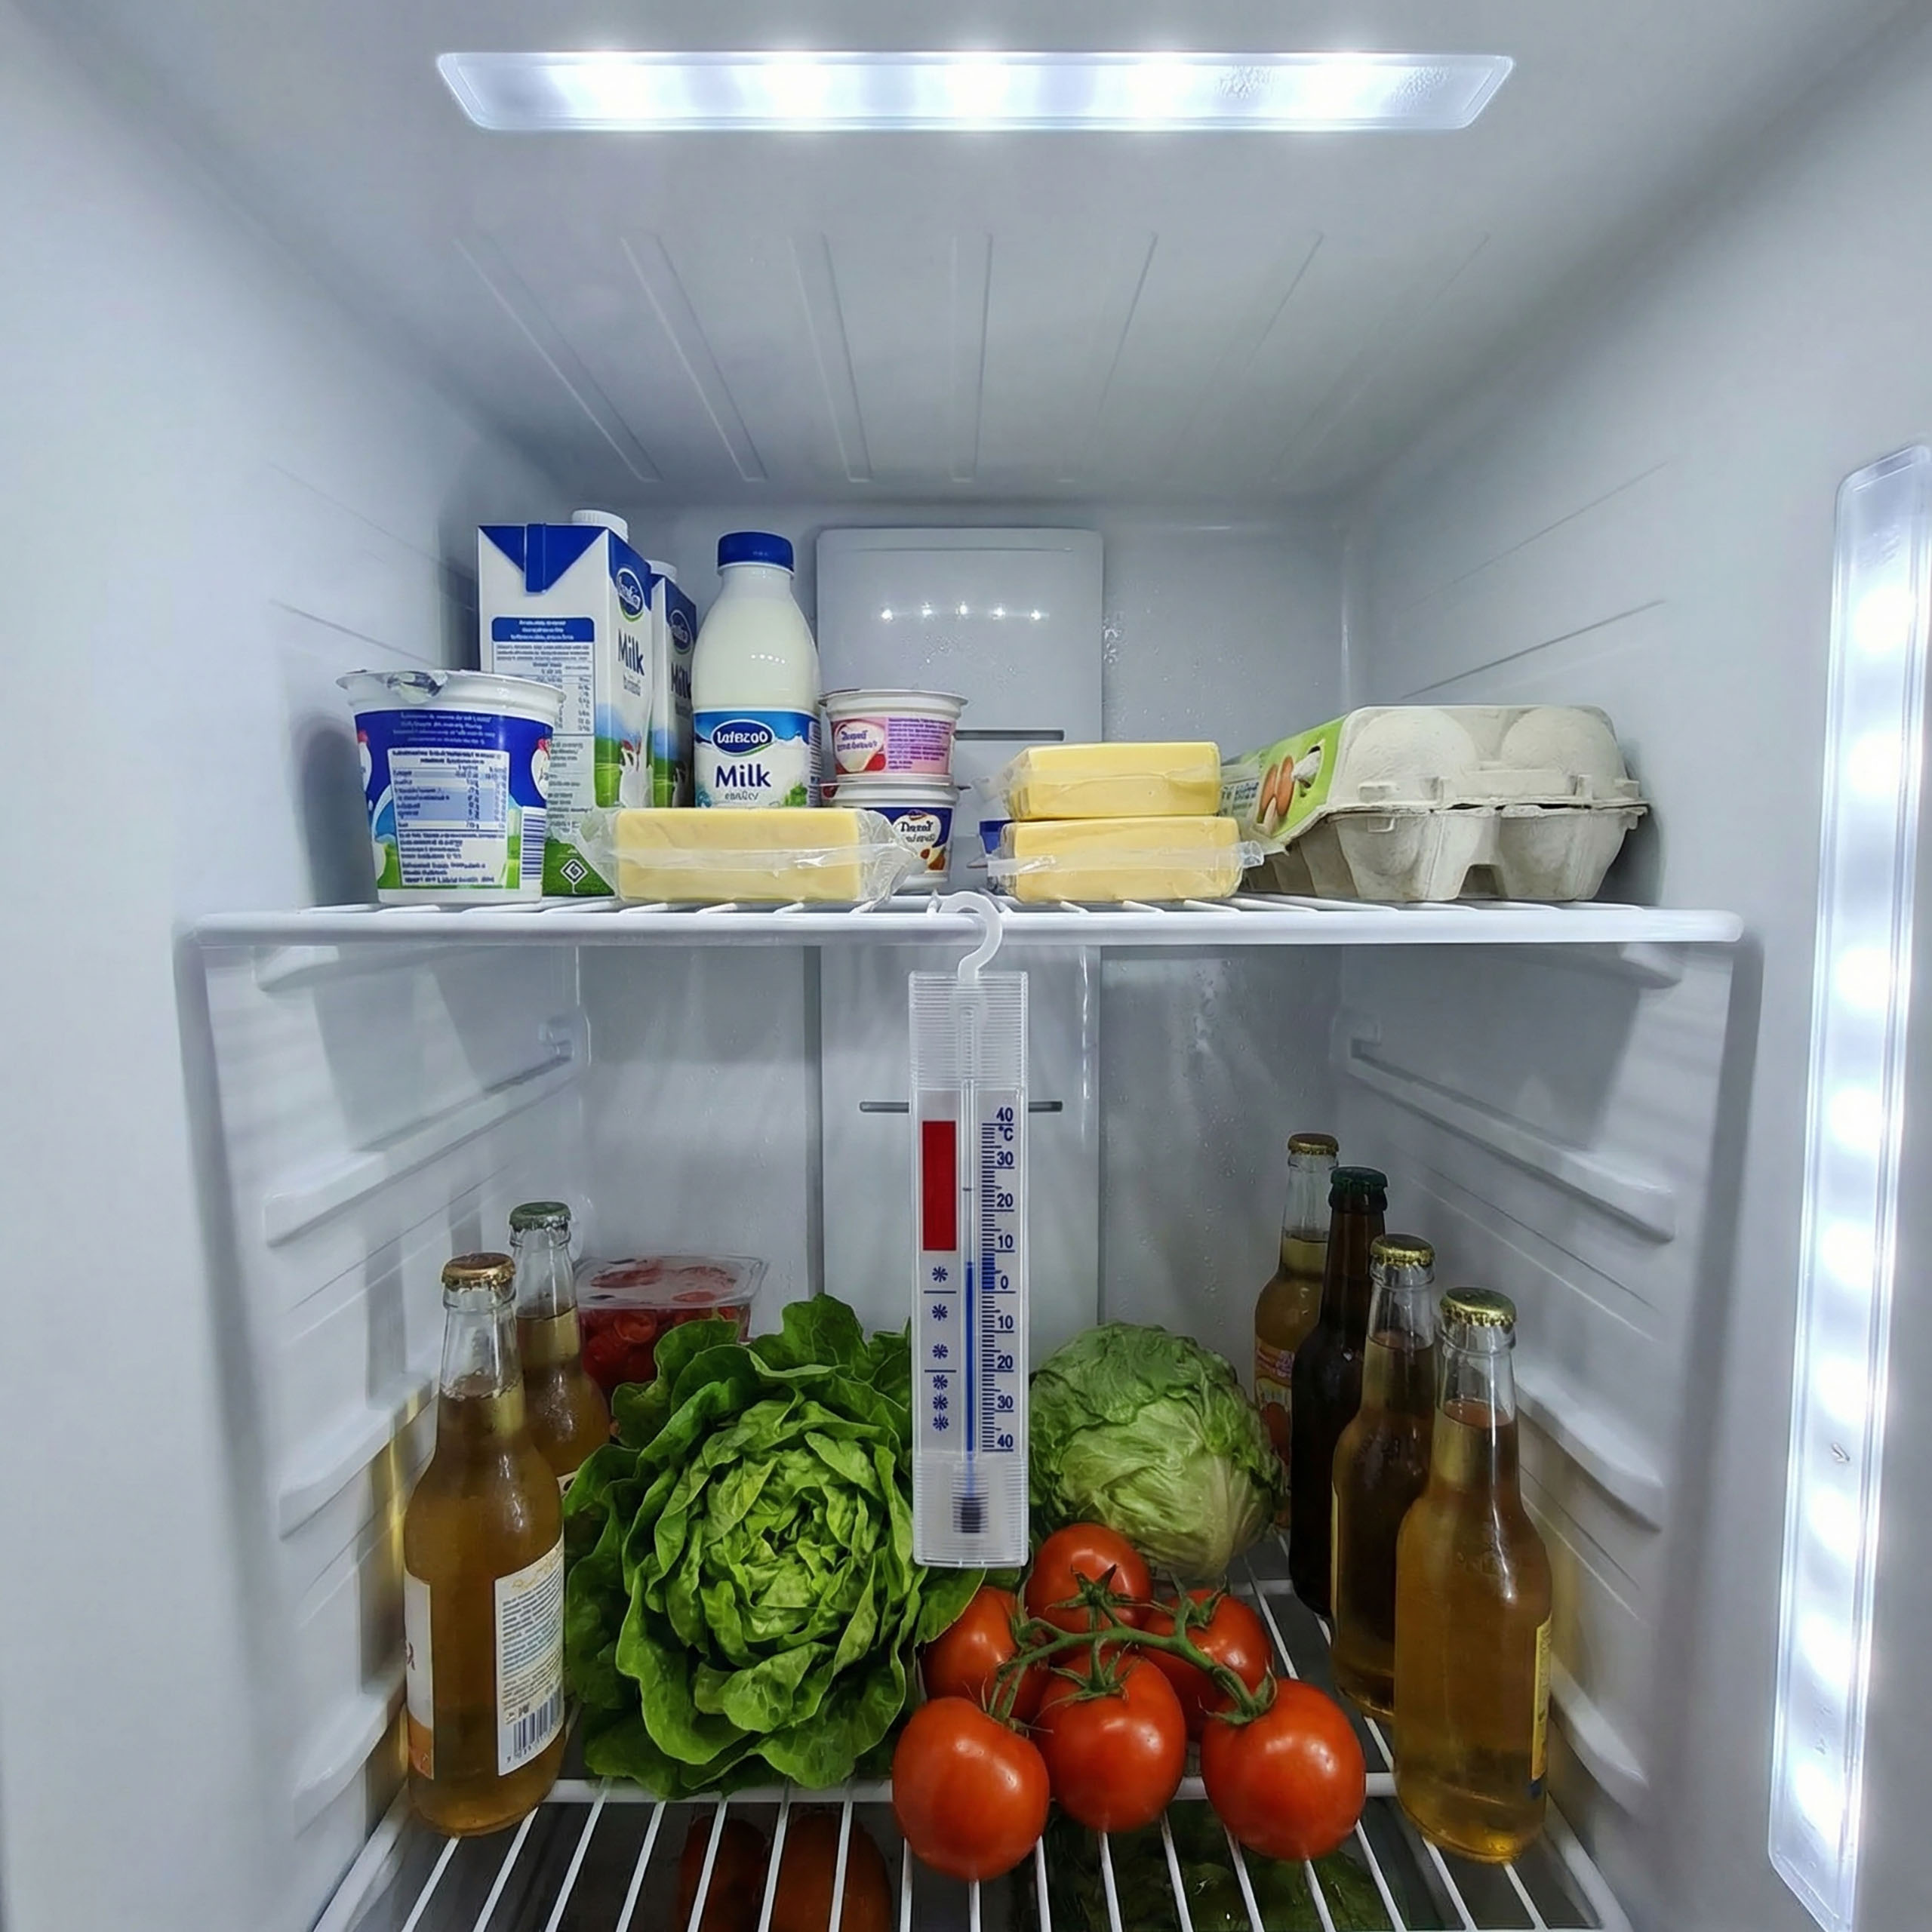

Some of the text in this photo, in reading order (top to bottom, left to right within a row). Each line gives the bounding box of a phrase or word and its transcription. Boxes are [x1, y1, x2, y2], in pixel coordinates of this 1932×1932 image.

[617, 627, 645, 676] Milk
[715, 763, 772, 789] Milk
[996, 1107, 1014, 1122] 40
[996, 1151, 1014, 1166] 30
[996, 1193, 1014, 1208] 20
[998, 1235, 1014, 1249] 10
[1000, 1275, 1009, 1290] 0
[998, 1315, 1014, 1330] 10
[997, 1355, 1014, 1370] 20
[997, 1395, 1014, 1409] 30
[997, 1434, 1014, 1447] 40
